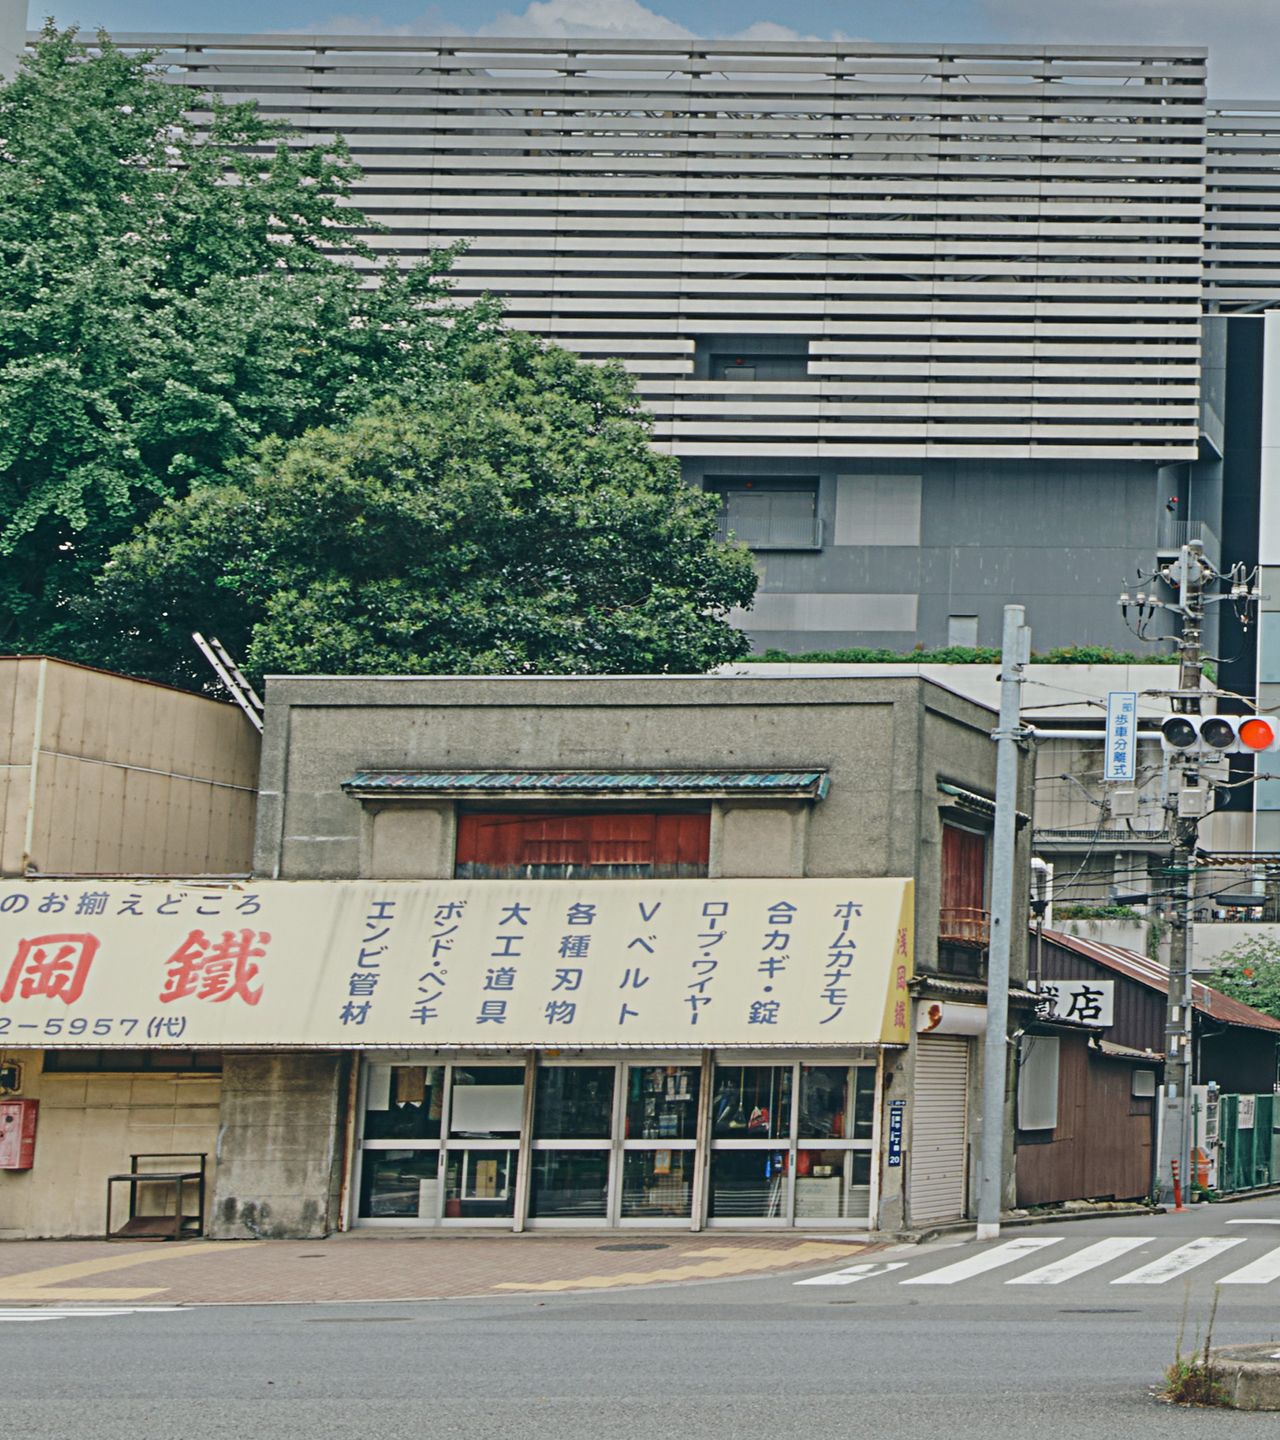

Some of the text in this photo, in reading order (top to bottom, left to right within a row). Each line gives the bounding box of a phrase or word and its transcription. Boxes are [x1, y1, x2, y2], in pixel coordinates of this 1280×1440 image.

[1113, 714, 1129, 776] 歩車分離式
[0, 891, 262, 916] のお揃えどころ
[339, 901, 396, 1026] エンビ管材
[409, 900, 468, 1026] ボンド・ペンキ
[475, 902, 532, 1025] 大工道具
[544, 902, 597, 1025] 各種刃物
[618, 901, 662, 1026] Vベルト
[747, 900, 798, 1026] 合カギ・錠
[819, 900, 863, 1026] ホームカナモノ
[889, 1156, 900, 1164] 20
